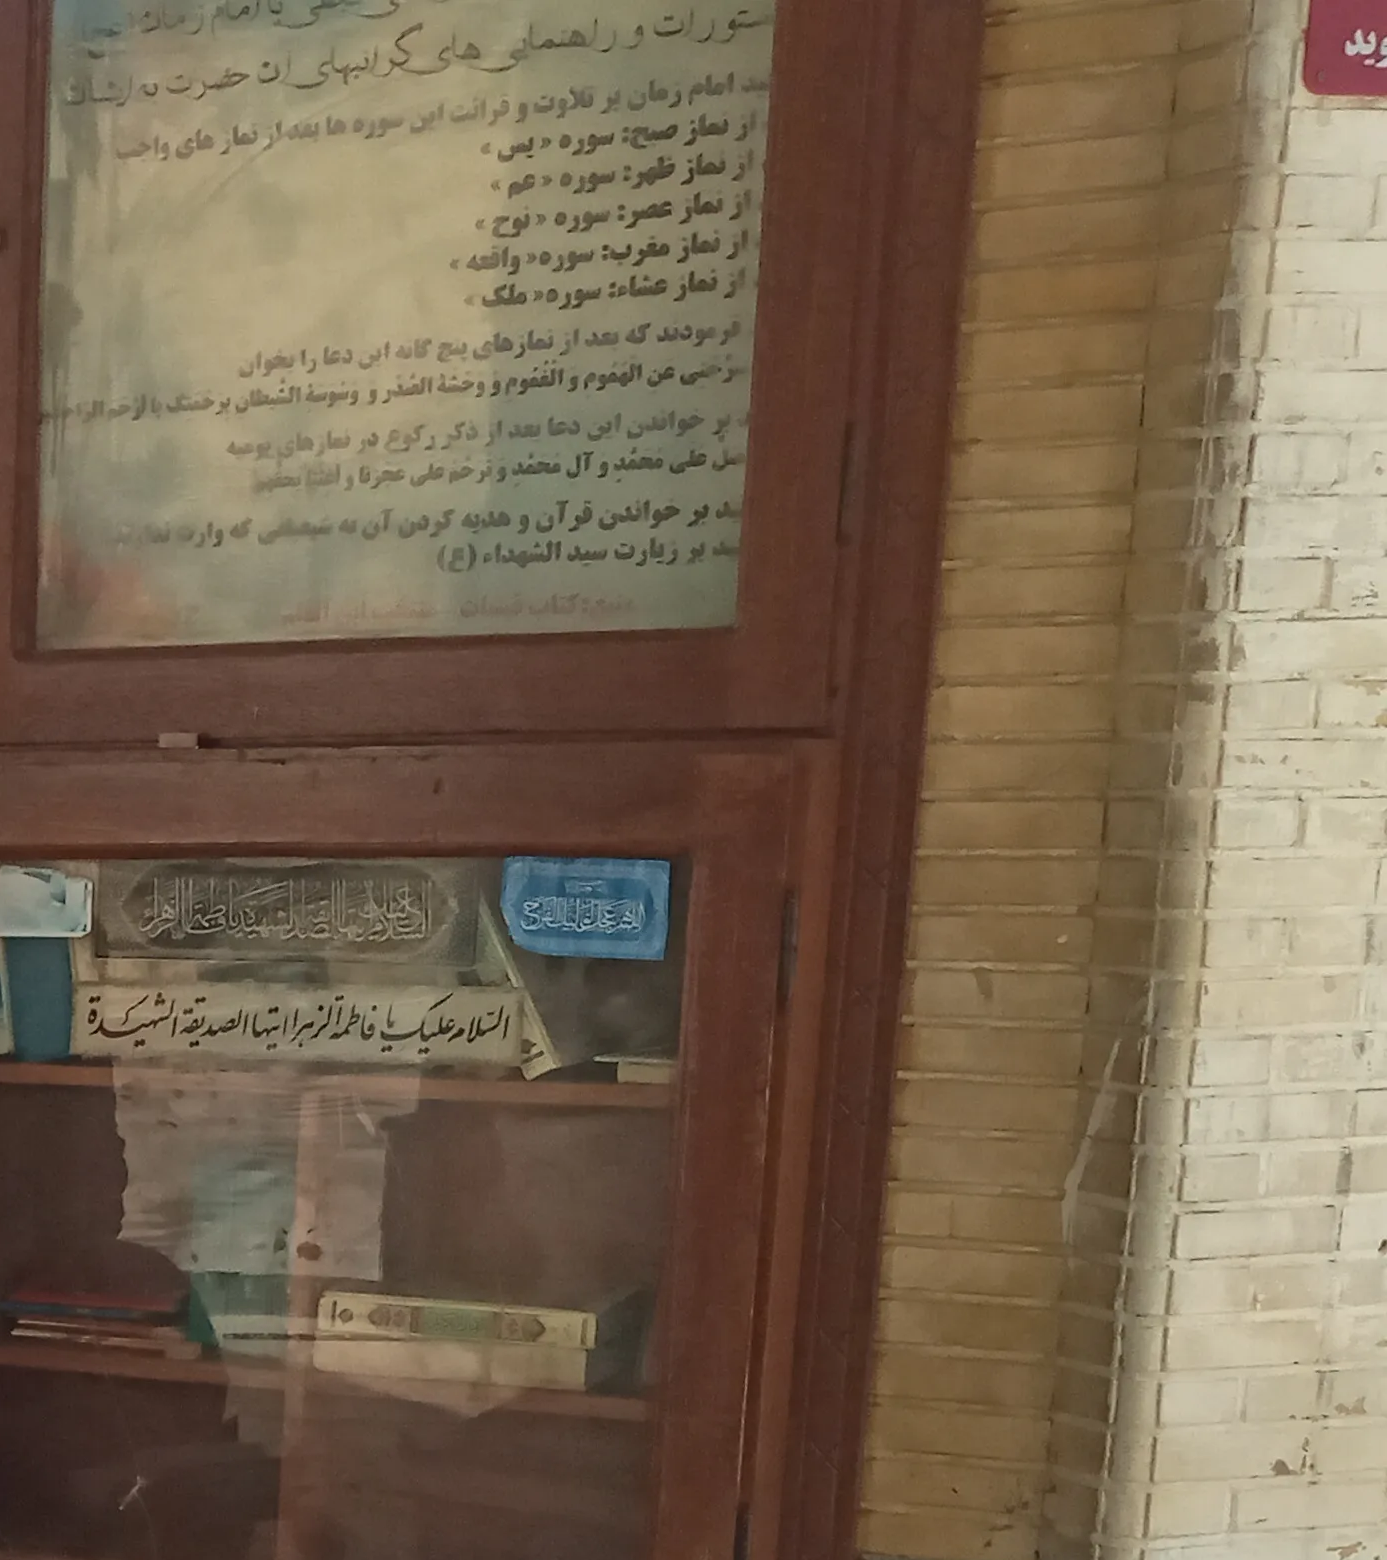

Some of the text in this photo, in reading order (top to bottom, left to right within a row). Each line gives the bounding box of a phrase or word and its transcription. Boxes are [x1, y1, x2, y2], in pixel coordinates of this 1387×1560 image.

[559, 132, 615, 156] سوره
[683, 114, 729, 146] نماز
[560, 171, 616, 194] سوره
[681, 153, 726, 185] نماز
[554, 210, 611, 233] سوره
[679, 192, 723, 225] نماز
[677, 232, 720, 263] نماز
[673, 269, 718, 302] نماز
